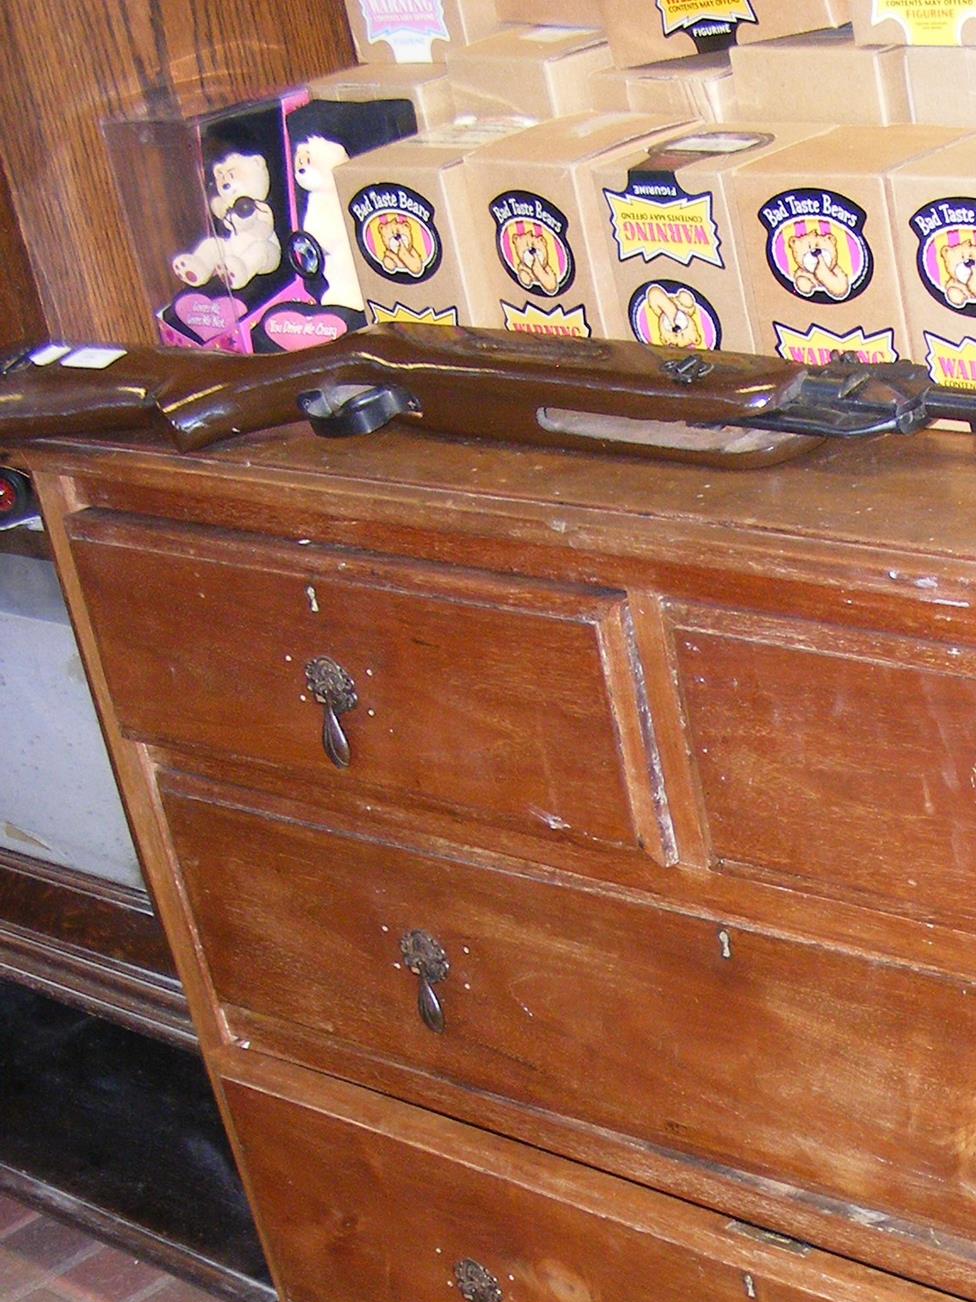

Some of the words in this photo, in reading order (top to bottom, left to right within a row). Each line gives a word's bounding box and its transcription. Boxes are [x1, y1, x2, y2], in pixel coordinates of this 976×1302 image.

[905, 9, 955, 19] FIGURINE
[692, 23, 732, 37] FIGURINE
[632, 185, 677, 197] FIGURINE
[353, 195, 374, 222] Bad
[369, 191, 398, 210] Taste
[398, 191, 431, 222] Bears
[493, 200, 512, 224] Bad
[508, 198, 535, 217] Taste
[535, 200, 562, 233] Bears
[763, 201, 790, 228] Bad
[785, 195, 820, 215] Taste
[822, 194, 858, 227] Bears
[668, 214, 703, 223] CONTENTS
[915, 208, 942, 236] Bad
[938, 203, 976, 224] Taste
[622, 221, 710, 245] WARNING
[788, 346, 886, 366] WARNG
